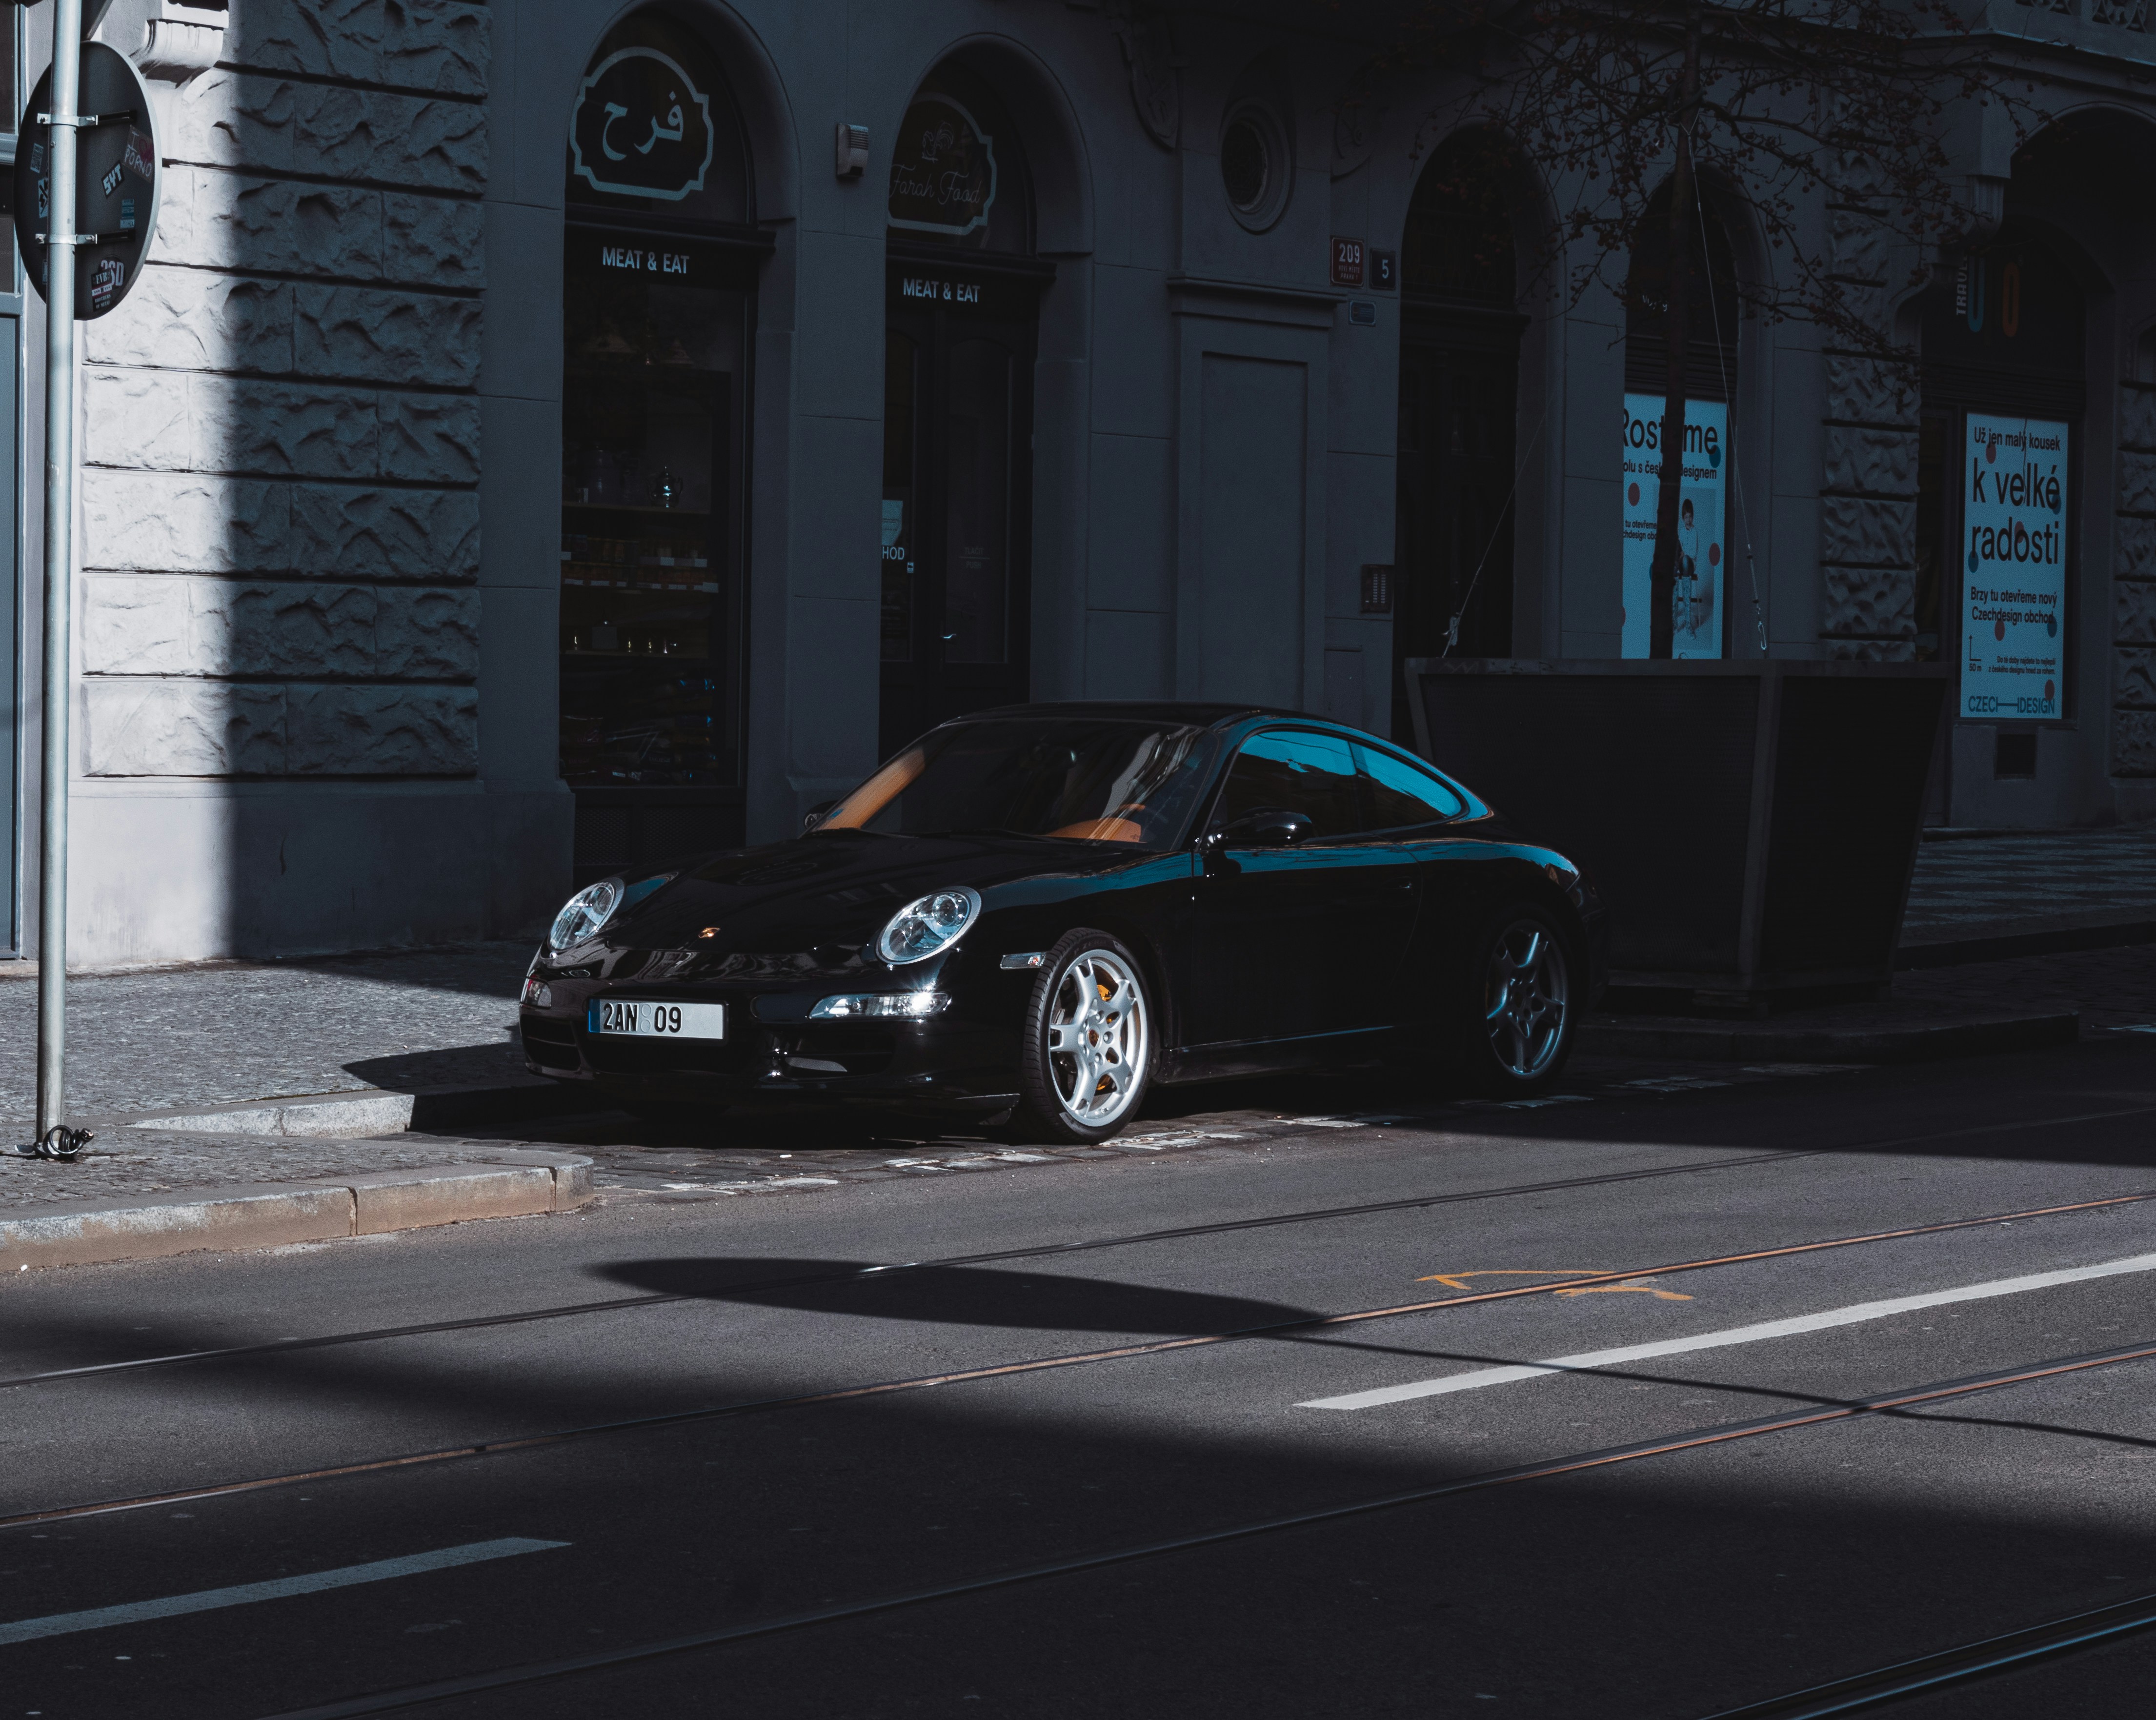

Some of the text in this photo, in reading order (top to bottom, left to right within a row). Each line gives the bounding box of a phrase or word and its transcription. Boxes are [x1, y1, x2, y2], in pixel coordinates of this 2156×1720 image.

[603, 91, 683, 161] فرح
[124, 148, 152, 177] PORNO
[889, 164, 982, 205] Farah Food
[603, 246, 689, 274] MEAT & EAT
[1339, 243, 1360, 263] 209
[1382, 259, 1389, 279] 5
[903, 278, 980, 303] MEAT & EAT
[1974, 426, 2060, 451] Už jen malý kousek
[1638, 464, 1643, 473] s
[1973, 457, 2060, 509] k velké
[1972, 516, 2059, 564] radosti
[1971, 587, 2057, 608] Brzy tu otevřeme nový
[1972, 606, 2054, 626] Czechdesign obchod
[1969, 663, 1976, 671] 50
[604, 1003, 682, 1032] 2AN 09
